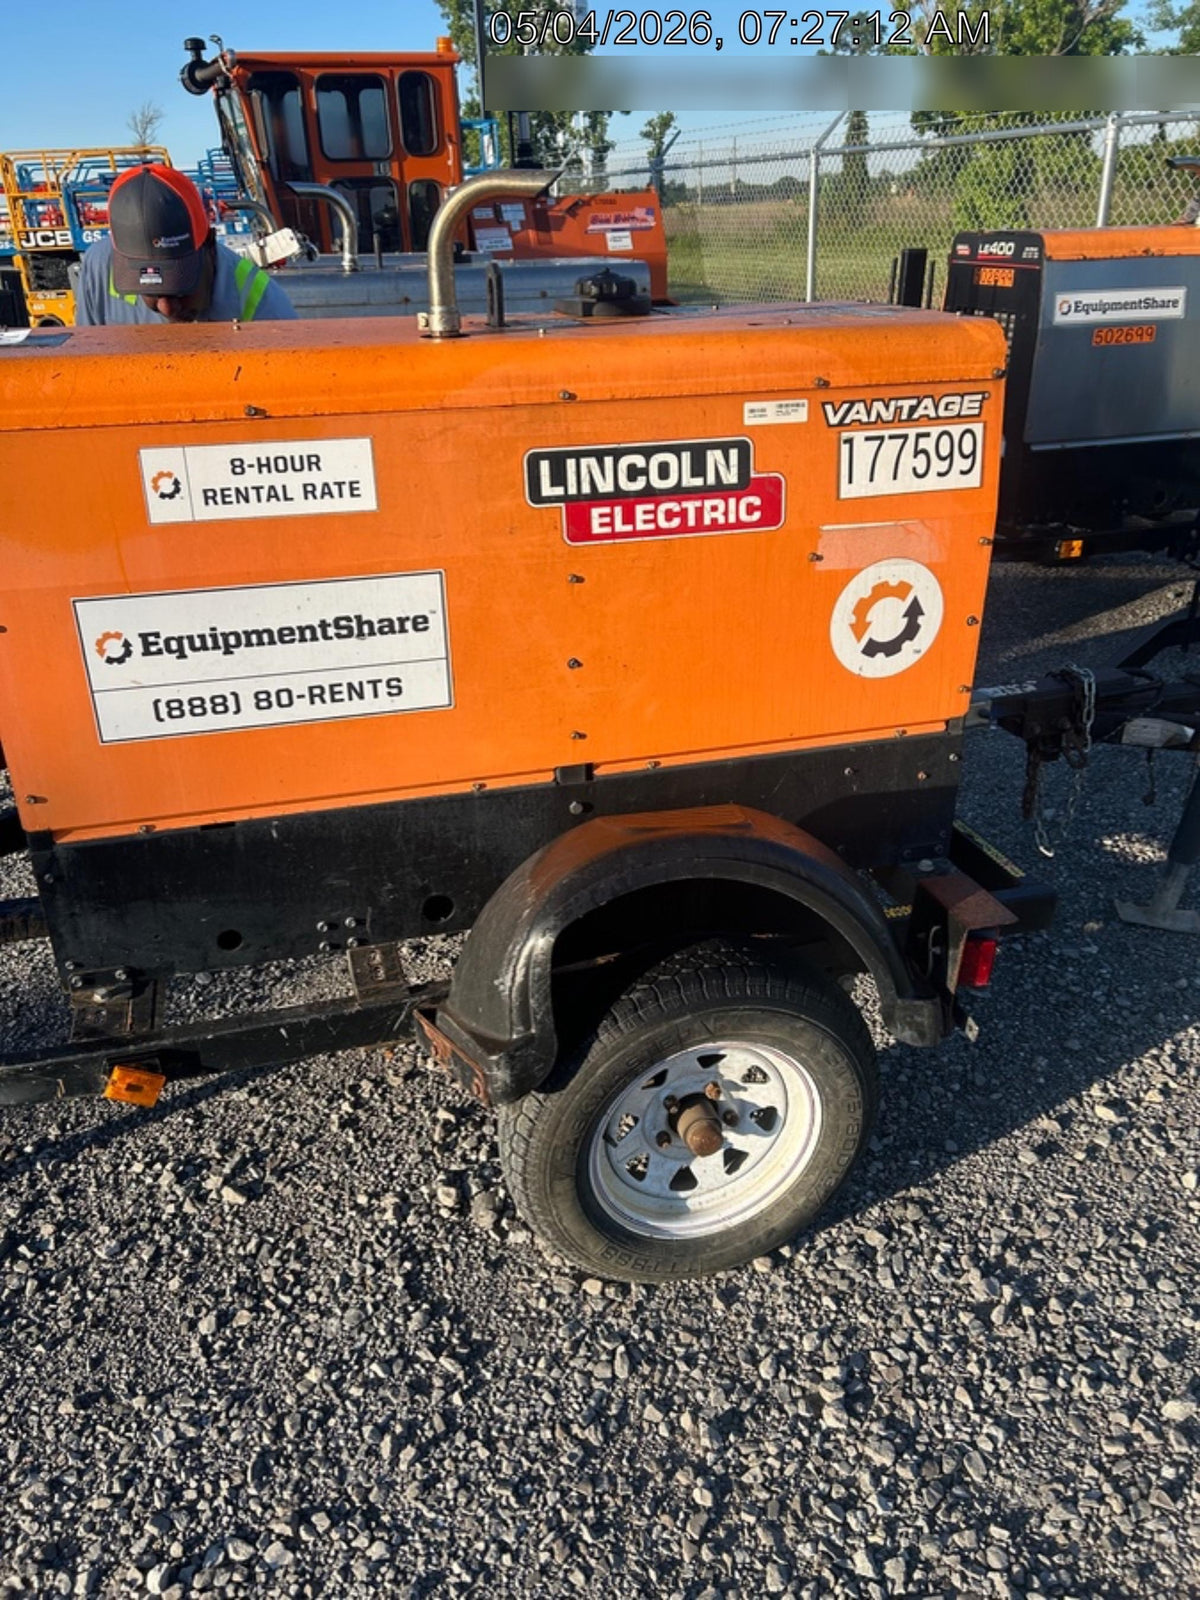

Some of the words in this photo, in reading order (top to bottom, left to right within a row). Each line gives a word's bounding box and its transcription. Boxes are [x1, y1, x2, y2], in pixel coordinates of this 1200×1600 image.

[21, 231, 72, 248] JCB
[1073, 297, 1179, 314] EquipmentShare
[1093, 326, 1155, 345] 502699
[822, 392, 983, 427] VANTAGE
[230, 454, 322, 476] 8-HOUR
[539, 448, 739, 497] LINCOLN
[842, 428, 978, 485] 177599
[202, 484, 294, 507] RENTAL
[302, 480, 362, 501] RATE
[591, 495, 762, 535] ELECTRIC
[138, 613, 430, 660] EquipmentShare
[152, 691, 242, 722] (888)
[254, 677, 402, 710] 80-RENTS
